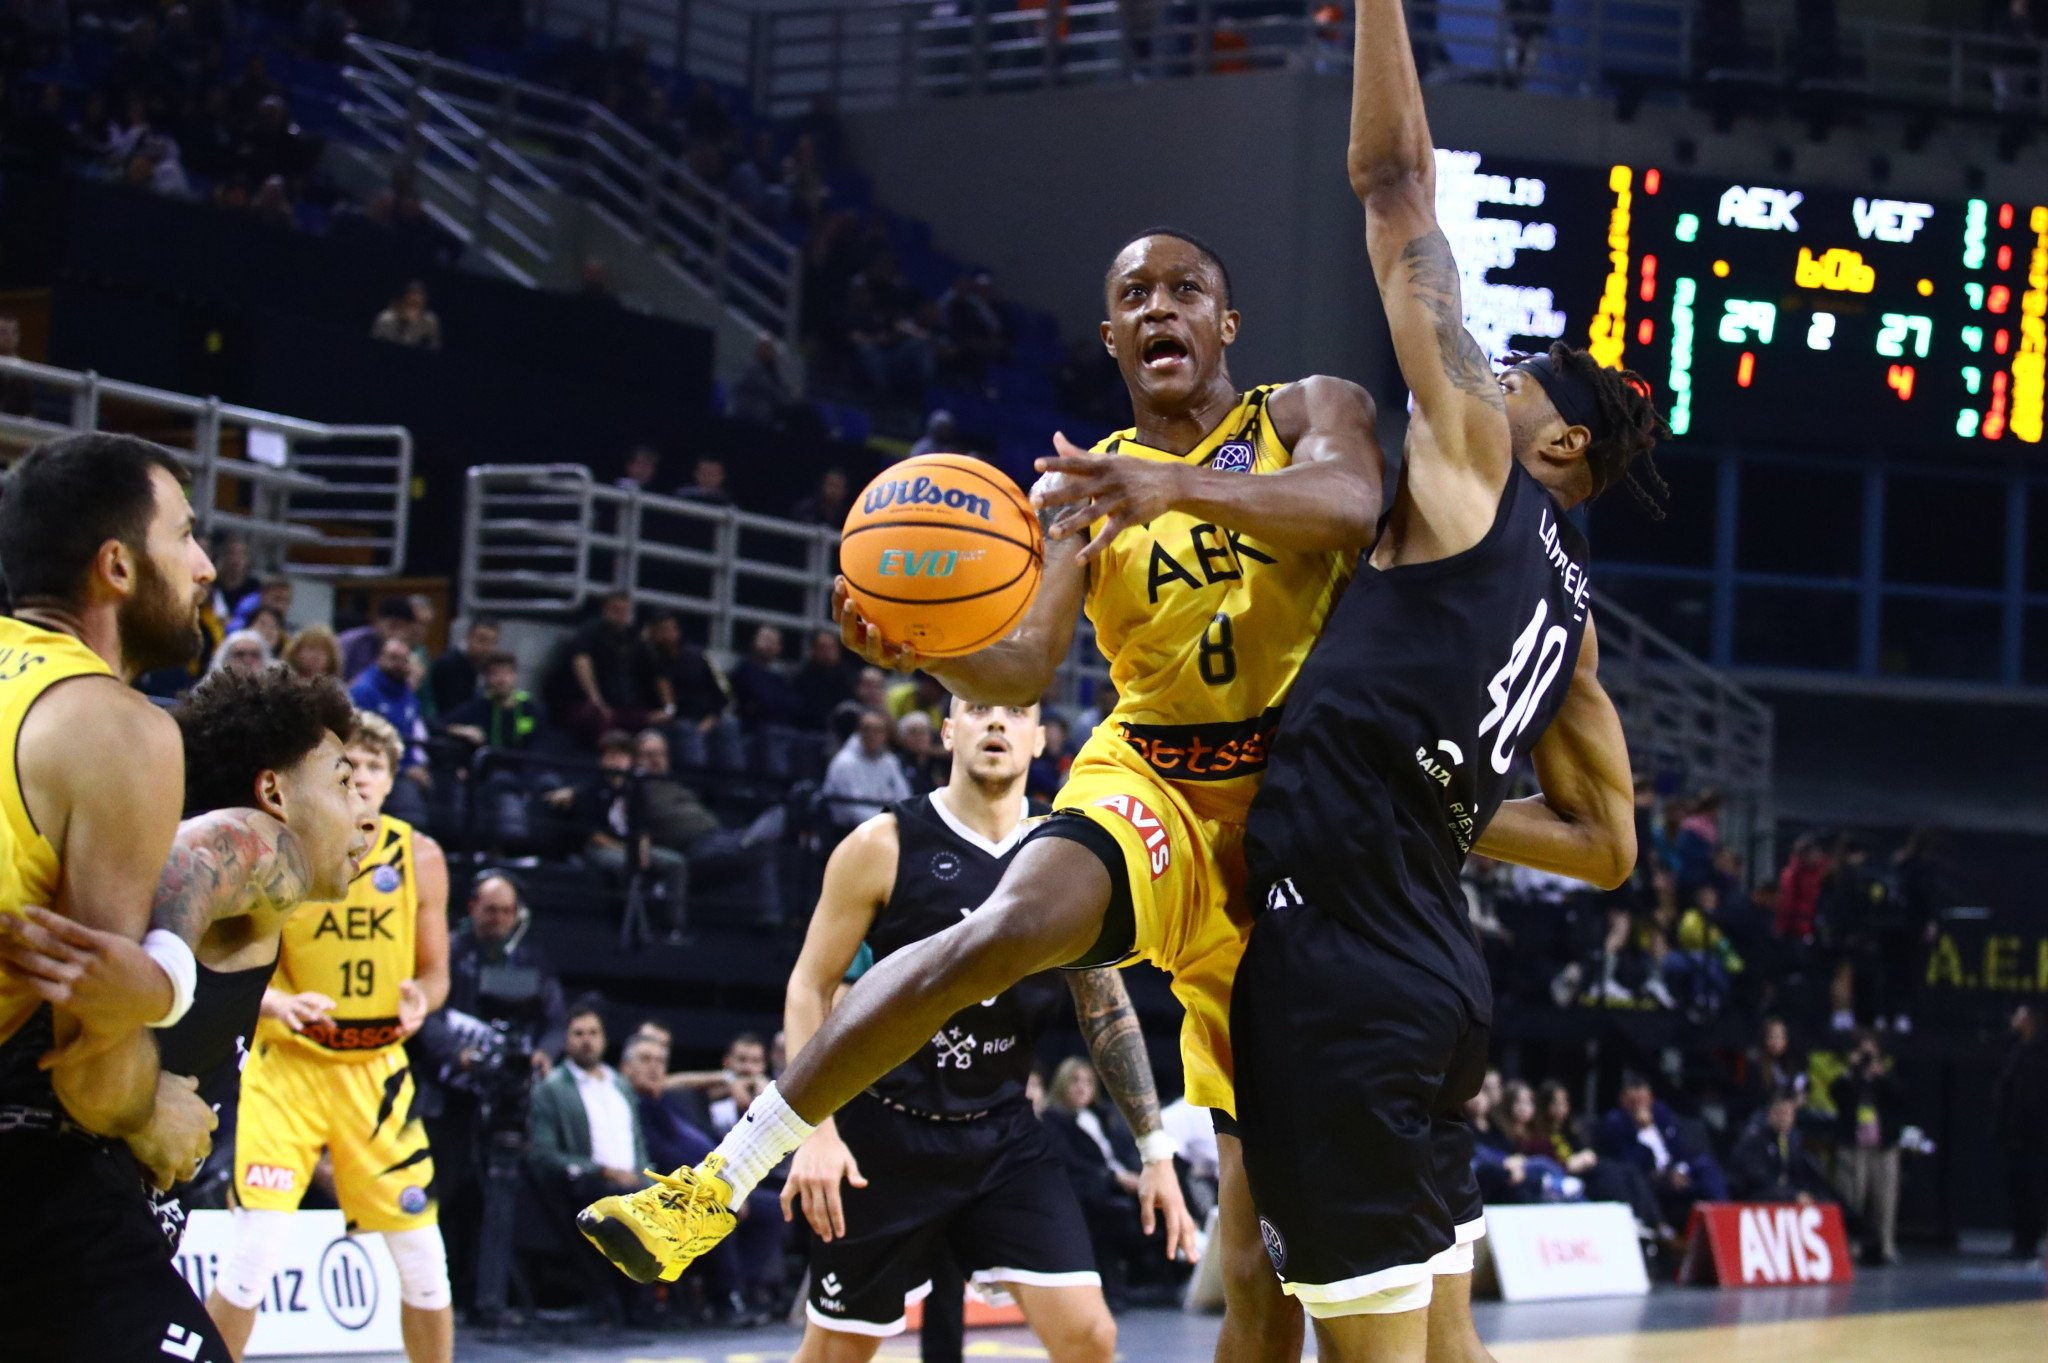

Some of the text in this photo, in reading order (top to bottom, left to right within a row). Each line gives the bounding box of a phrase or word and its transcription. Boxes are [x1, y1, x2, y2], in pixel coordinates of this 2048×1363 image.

[1718, 185, 1803, 231] AEK
[1853, 197, 1934, 243] VEF
[1719, 299, 1932, 358] 29 2 27
[1887, 364, 1915, 400] 4
[864, 476, 991, 521] Wilson
[878, 549, 958, 577] EVO
[1147, 523, 1279, 604] AEK
[1198, 611, 1237, 686] 8
[1478, 598, 1568, 775] 40
[1118, 728, 1279, 775] betss
[1415, 746, 1452, 787] BALTA
[1094, 795, 1169, 875] AVIS
[314, 907, 395, 940] AEK
[339, 959, 375, 998] 19
[246, 1164, 294, 1190] AVIS
[1739, 1206, 1833, 1284] AVIS
